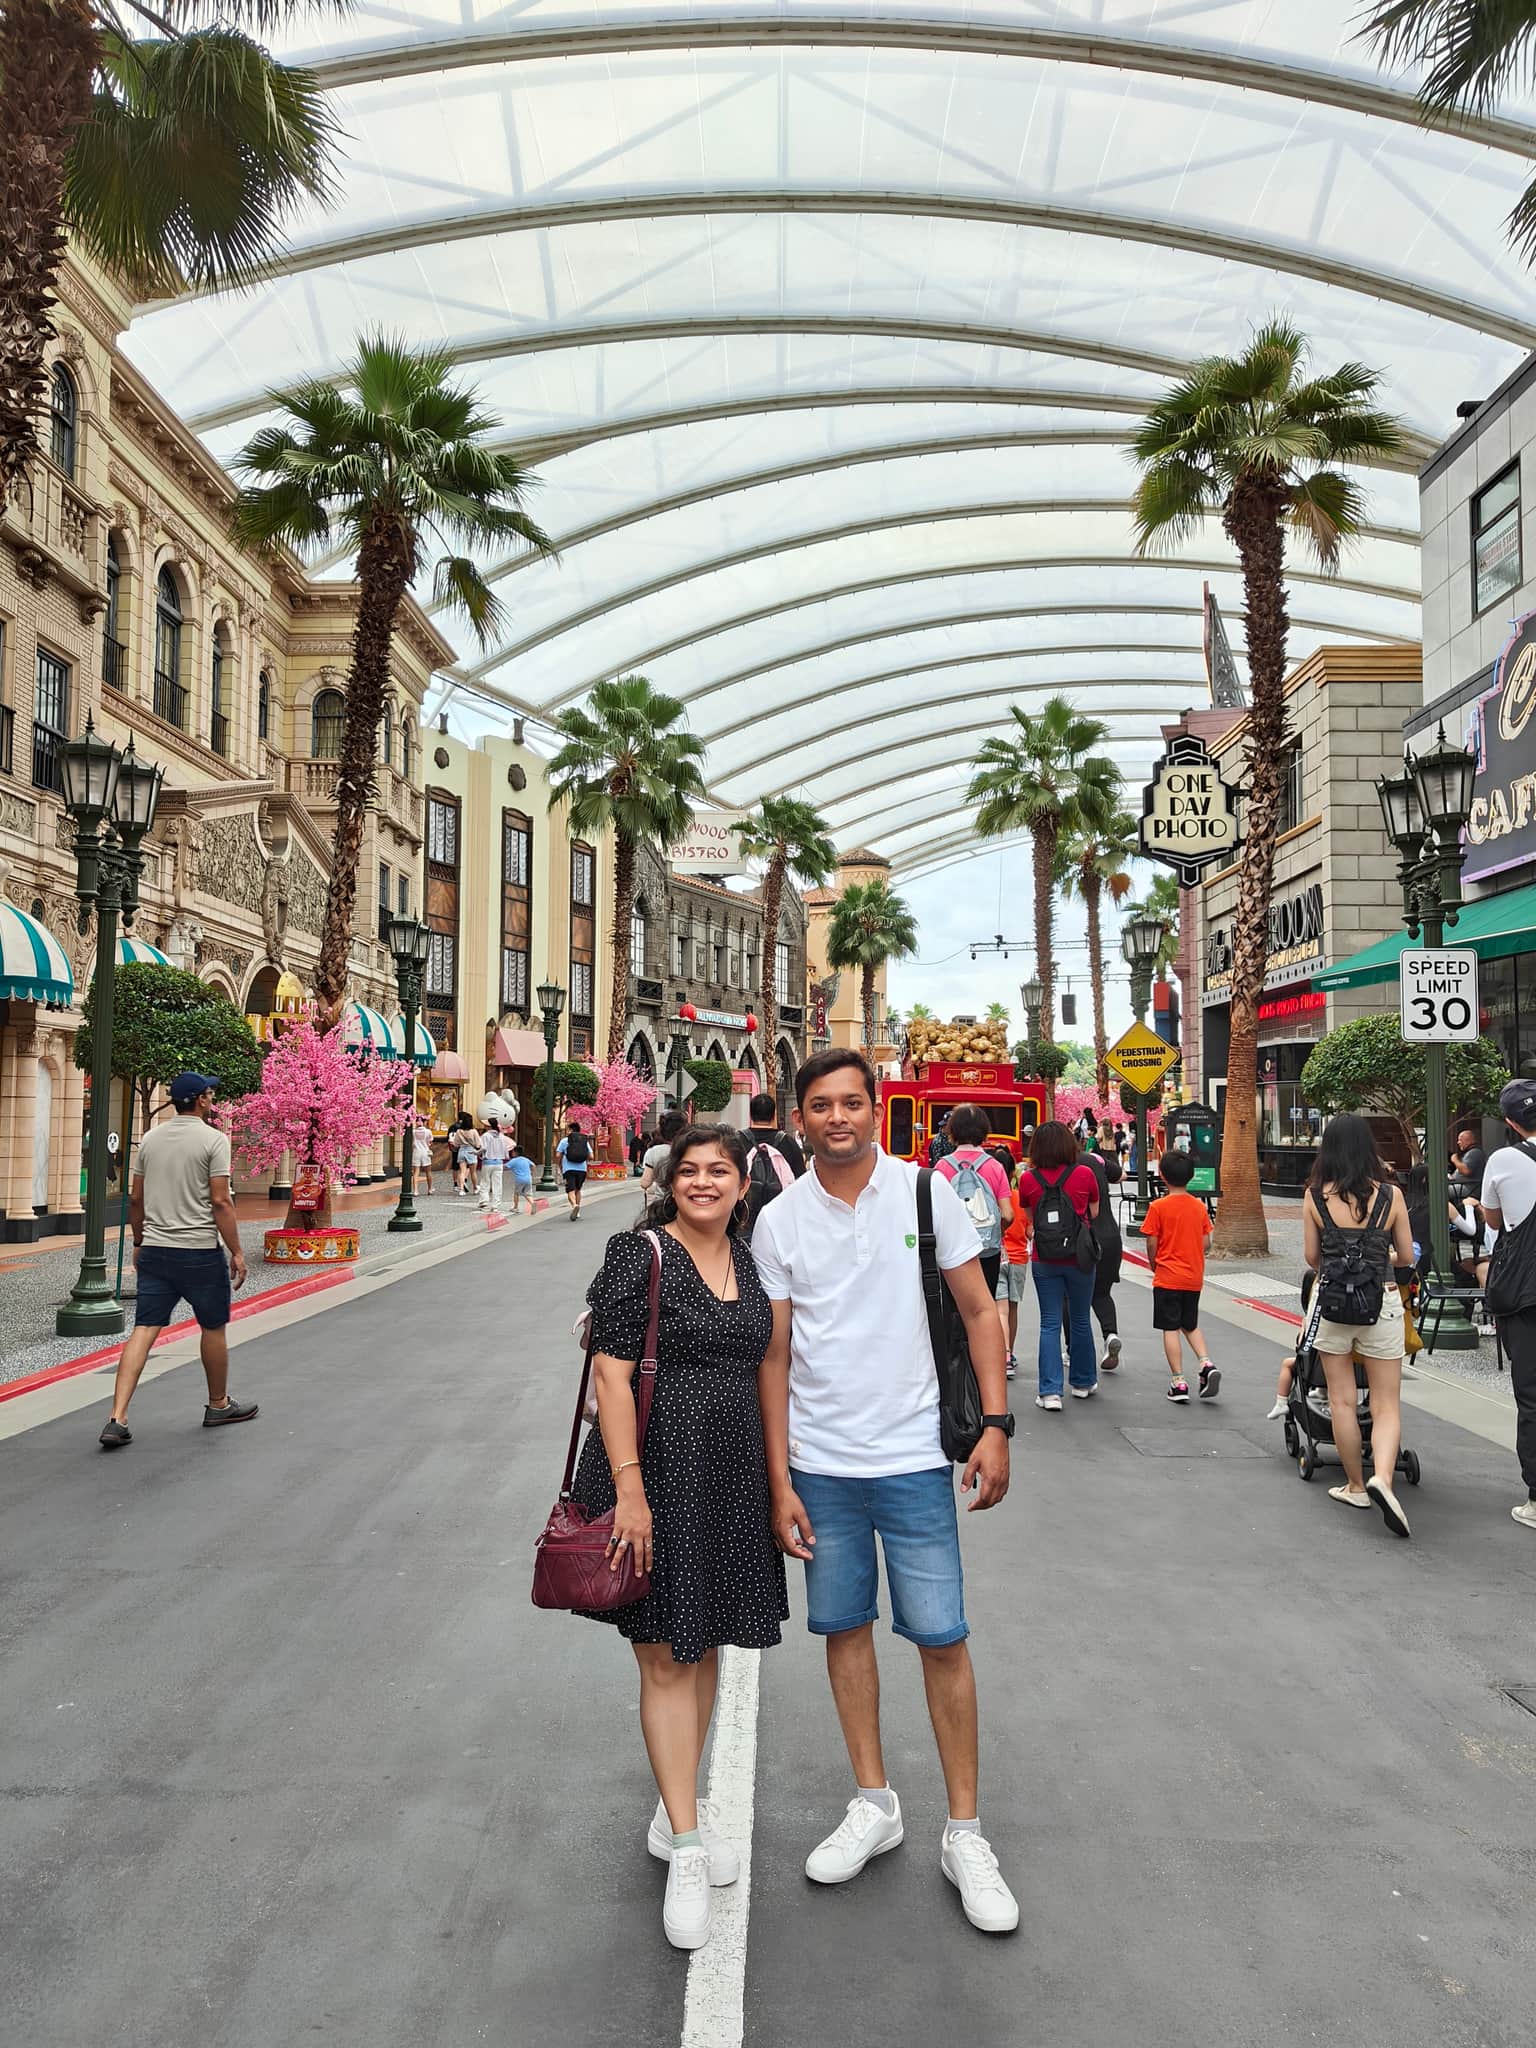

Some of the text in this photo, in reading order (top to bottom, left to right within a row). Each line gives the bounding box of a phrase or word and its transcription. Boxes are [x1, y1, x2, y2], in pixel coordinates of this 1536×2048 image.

[1167, 774, 1212, 793] ONE
[1170, 797, 1211, 816] DAY
[1466, 771, 1536, 845] CAF
[687, 822, 728, 840] WOOD
[1154, 819, 1227, 838] PHOTO
[671, 846, 729, 859] BISTRO
[1408, 961, 1470, 975] SPEED
[1416, 979, 1462, 993] LIMIT
[1409, 997, 1471, 1030] 30
[1116, 1046, 1166, 1057] PEDESTRIAN
[1121, 1057, 1162, 1068] CROSSING
